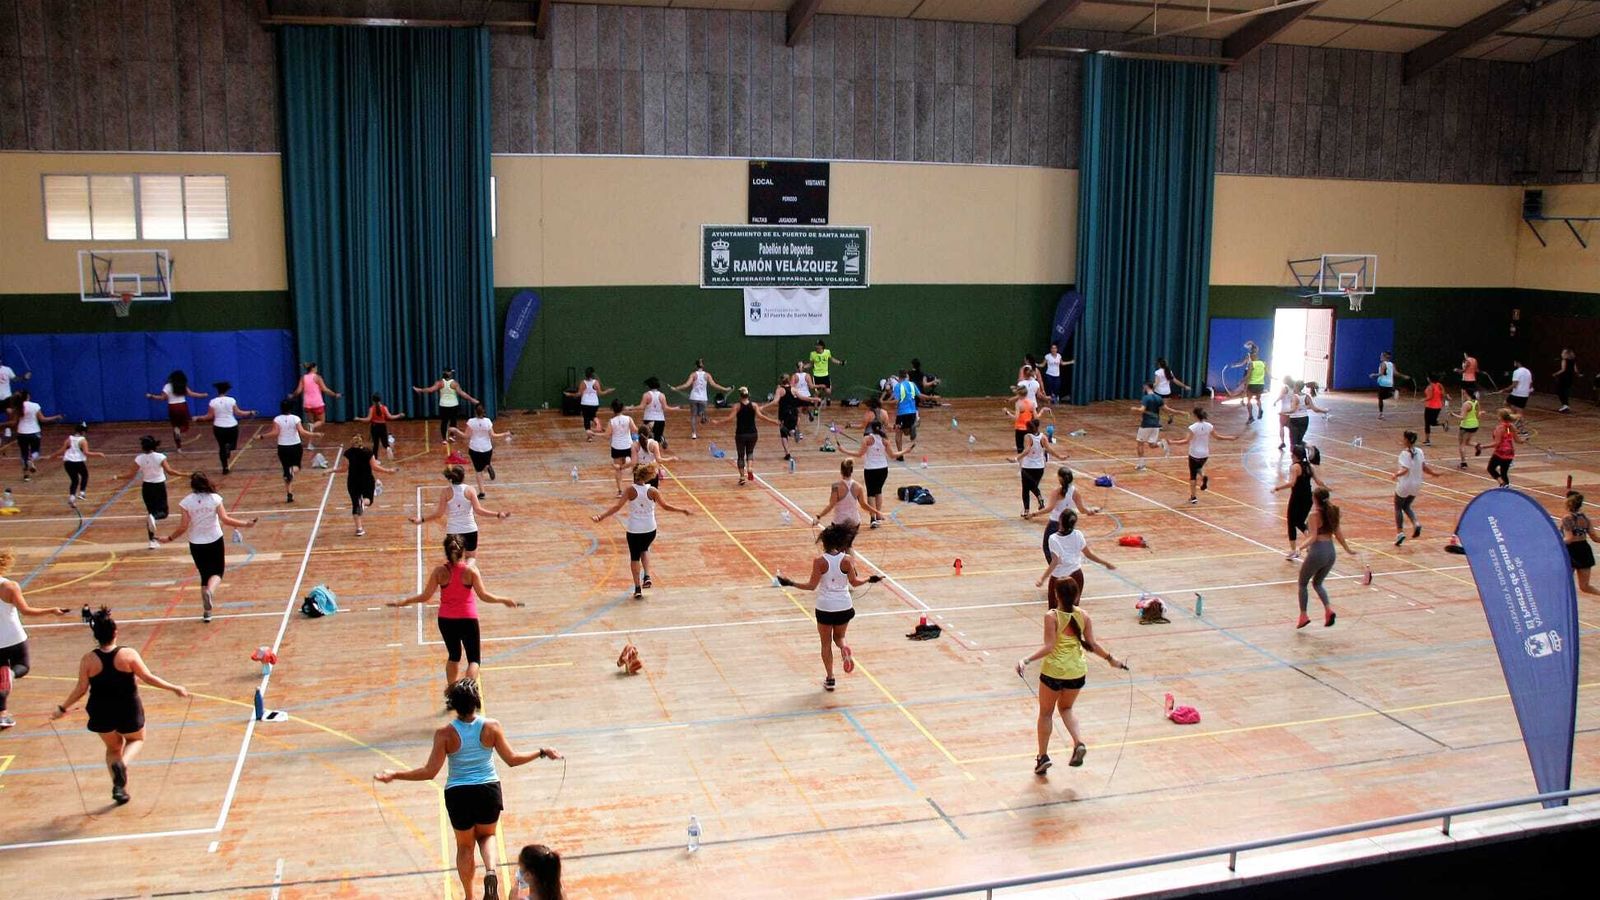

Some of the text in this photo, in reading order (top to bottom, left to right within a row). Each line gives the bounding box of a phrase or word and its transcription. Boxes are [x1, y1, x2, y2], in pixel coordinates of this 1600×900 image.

[759, 243, 814, 257] Pabellón de Deportes
[733, 257, 838, 273] RAMÓN VELÁZQUEZ
